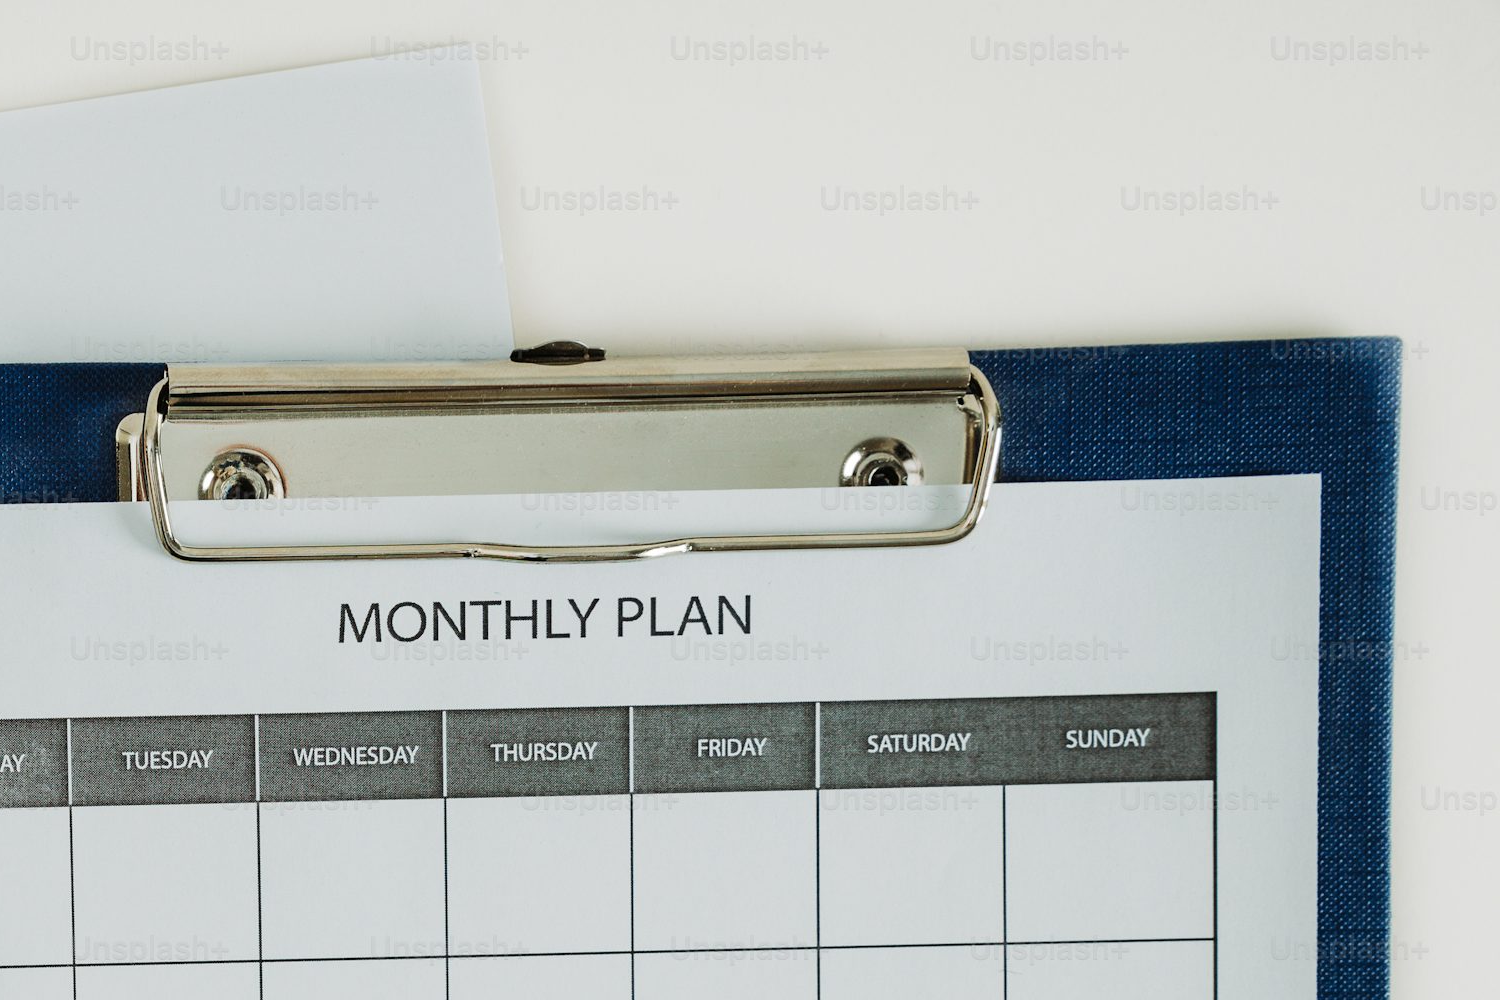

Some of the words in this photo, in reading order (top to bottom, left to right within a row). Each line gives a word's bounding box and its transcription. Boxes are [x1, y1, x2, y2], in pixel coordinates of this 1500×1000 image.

[338, 597, 600, 644] MONTHLY
[617, 594, 752, 638] PLAN
[122, 750, 214, 770] TUESDAY
[293, 745, 419, 766] WEDNESDAY
[491, 741, 598, 762] THURSDAY
[697, 737, 767, 757] FRIDAY
[867, 732, 971, 754] SATURDAY
[1066, 728, 1151, 748] SUNDAY
